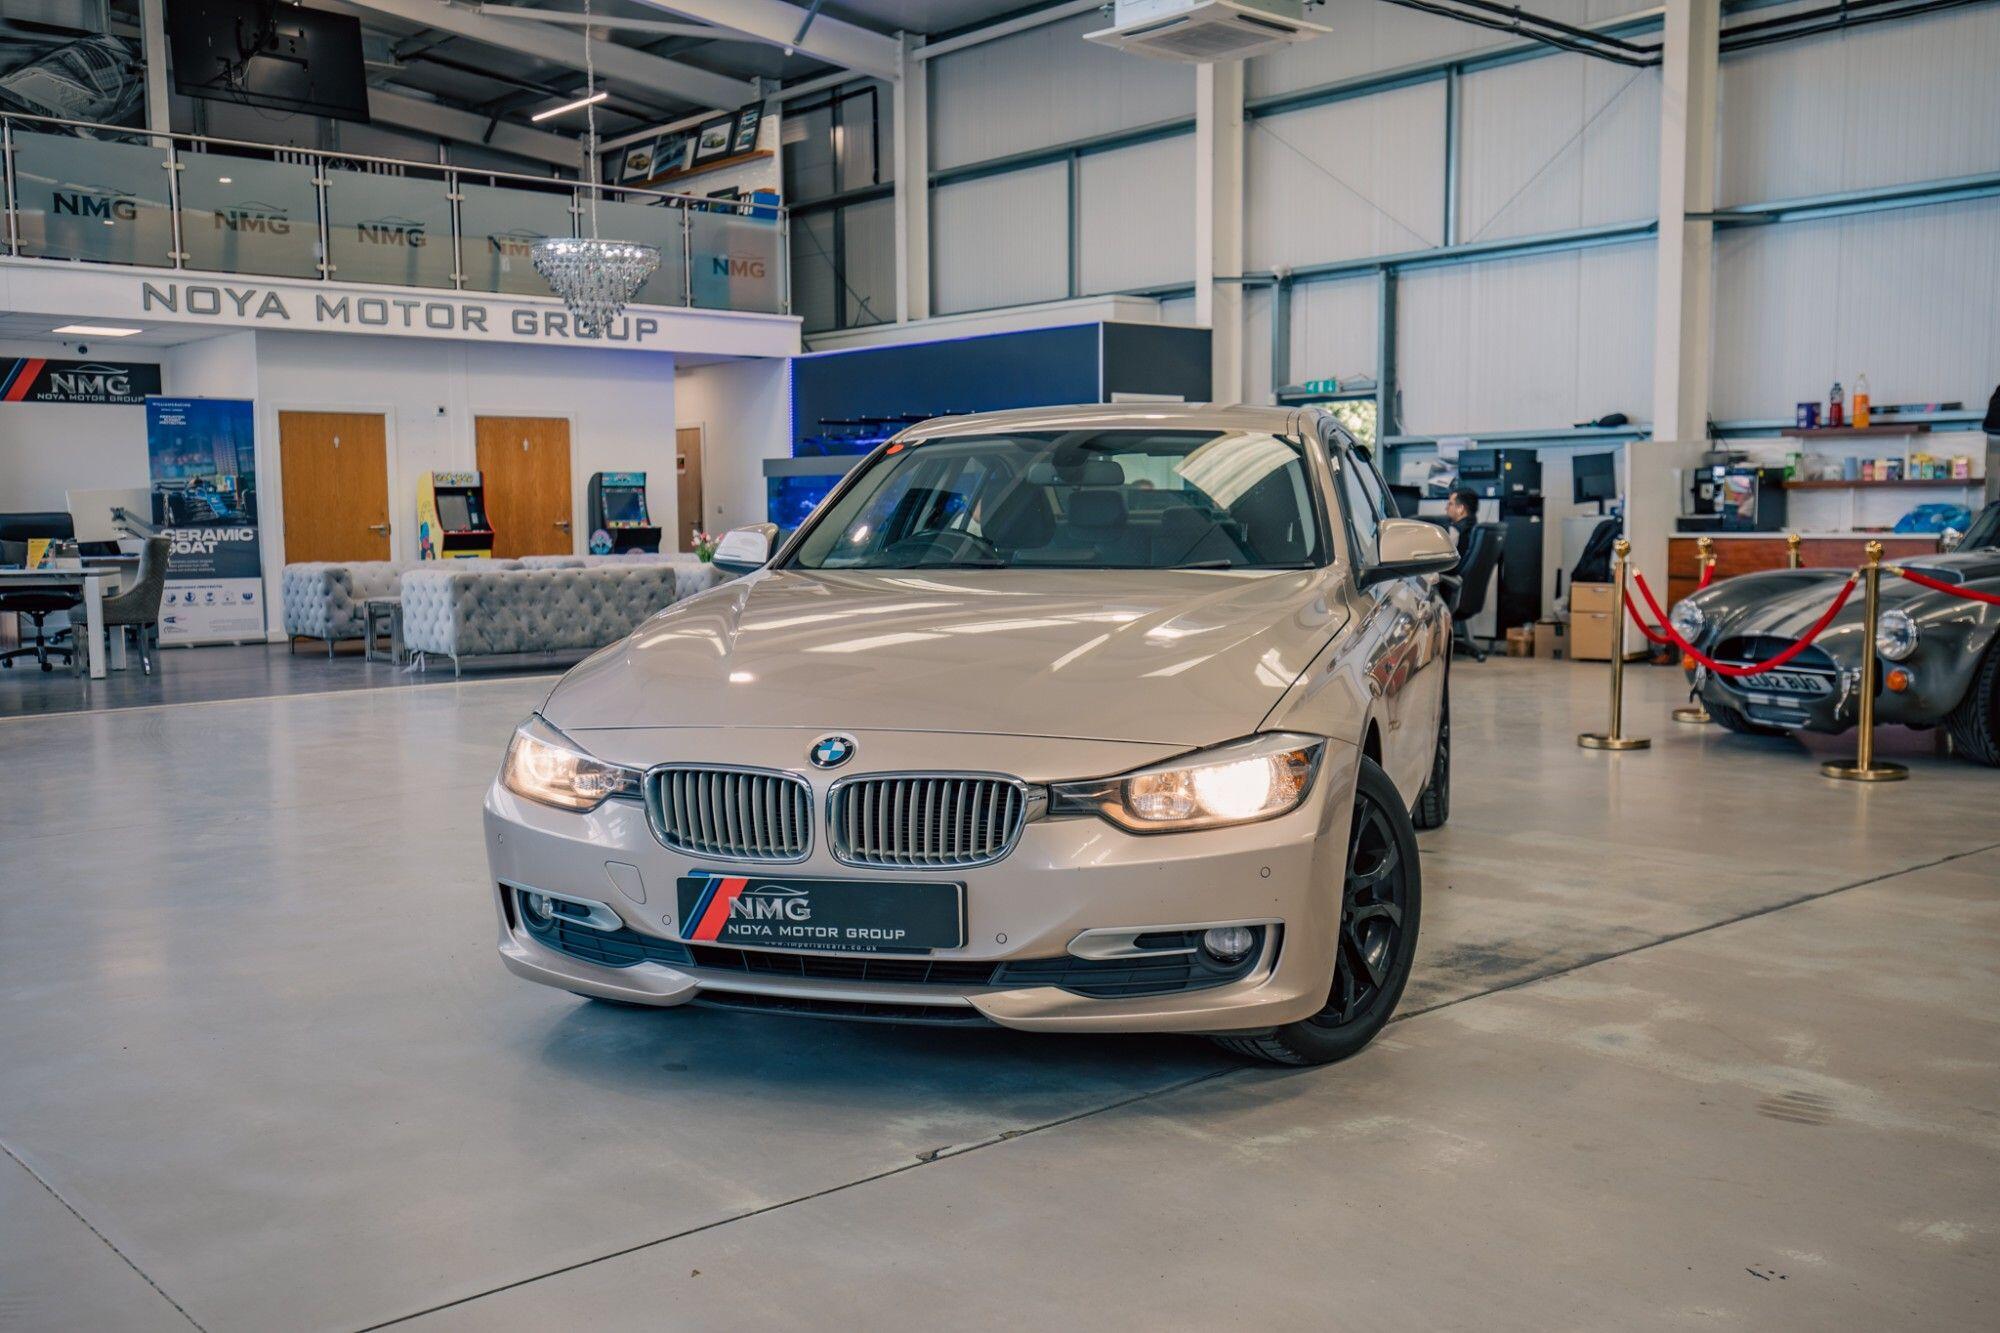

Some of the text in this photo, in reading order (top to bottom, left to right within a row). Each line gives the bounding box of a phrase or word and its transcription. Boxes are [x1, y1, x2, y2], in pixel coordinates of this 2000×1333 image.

[53, 192, 137, 221] NMG
[215, 209, 290, 235] NMG
[357, 224, 426, 248] NMG
[487, 234, 531, 257] NM
[713, 257, 765, 279] NMG
[142, 281, 291, 320] NOYA
[315, 294, 488, 332] MOTOR
[50, 373, 131, 396] NMG
[36, 392, 145, 403] NOYA MOTOR GROUP
[161, 528, 254, 542] CERAMIC
[728, 896, 812, 921] NMG
[728, 924, 906, 941] NOYA MOTOR GROUP
